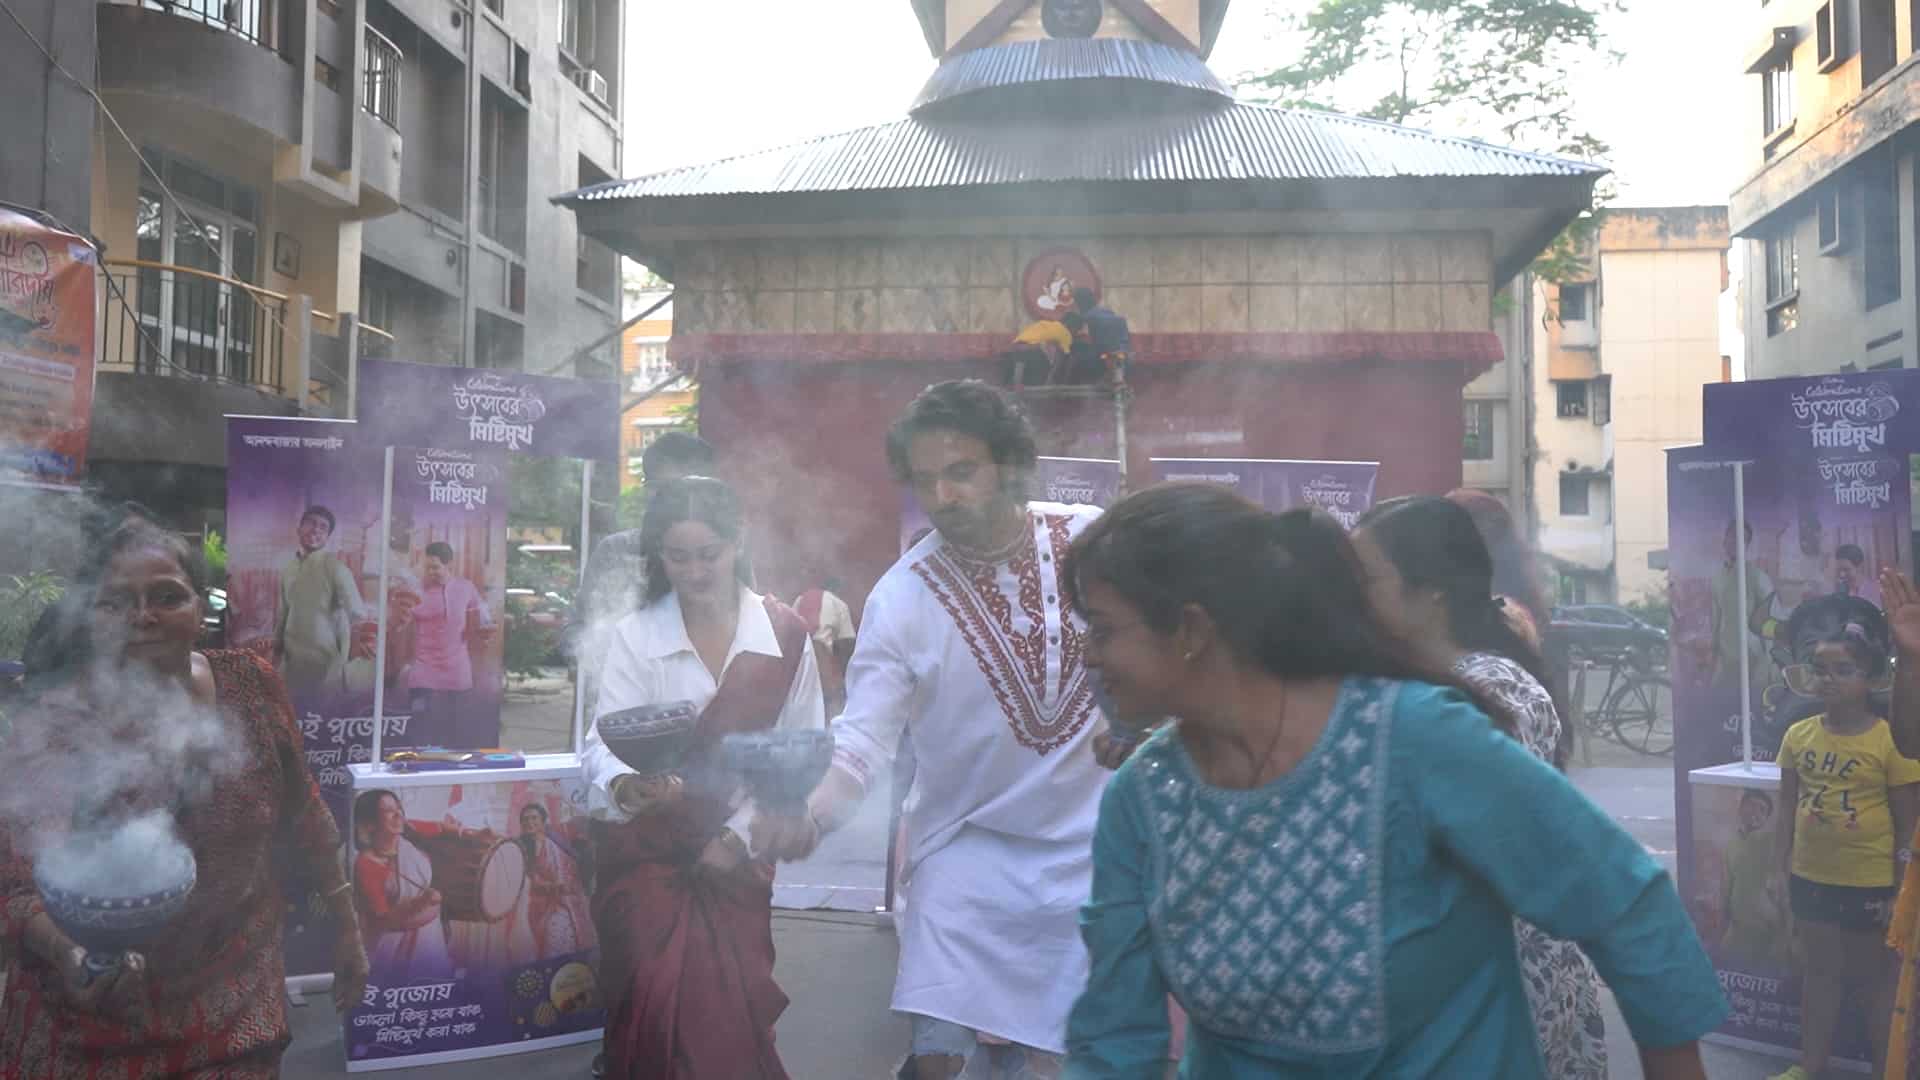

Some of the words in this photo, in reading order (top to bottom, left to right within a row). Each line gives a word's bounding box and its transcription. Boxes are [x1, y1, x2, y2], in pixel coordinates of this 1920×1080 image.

[453, 384, 522, 417] উৎসবের
[1791, 393, 1870, 421] উৎসবের
[469, 416, 534, 449] মিষ্টিমুখ
[1811, 421, 1887, 453] মিষ্টিমুখ
[415, 453, 478, 481] উৎসবের
[1817, 457, 1879, 481] উৎসবের
[430, 480, 488, 510] মিষ্টিমুখ
[1835, 480, 1891, 510] মিষ্টিমুখ
[1804, 750, 1862, 781] SHE
[383, 983, 456, 1009] পুজোয়
